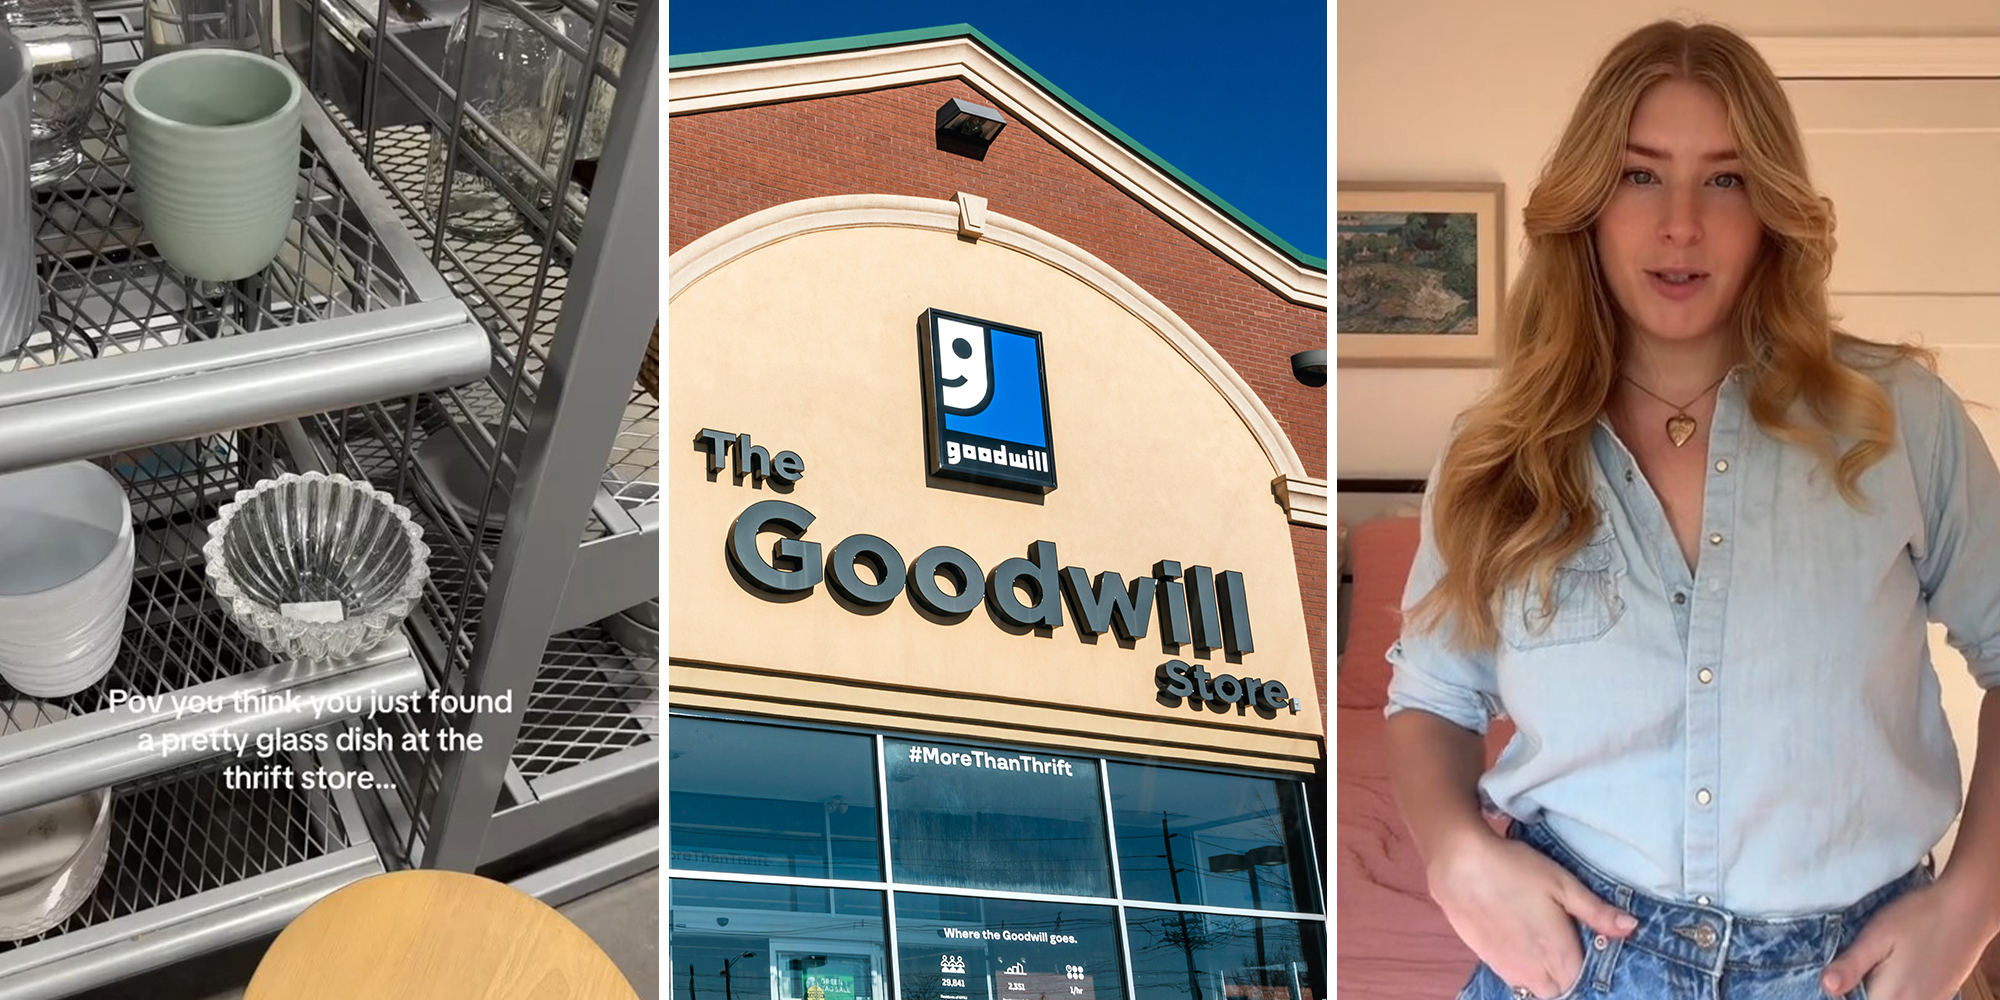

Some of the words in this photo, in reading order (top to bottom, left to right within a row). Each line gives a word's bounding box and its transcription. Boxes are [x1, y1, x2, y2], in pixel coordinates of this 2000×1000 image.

[694, 428, 805, 484] The
[946, 441, 1049, 472] goodwill
[728, 500, 1255, 656] Goodwill
[909, 745, 1073, 777] #MoreThanThrift
[943, 928, 981, 939] Where
[982, 929, 1000, 940] the
[1002, 930, 1048, 943] Goodwill
[1050, 934, 1078, 945] goes.
[941, 978, 966, 988] 29,841
